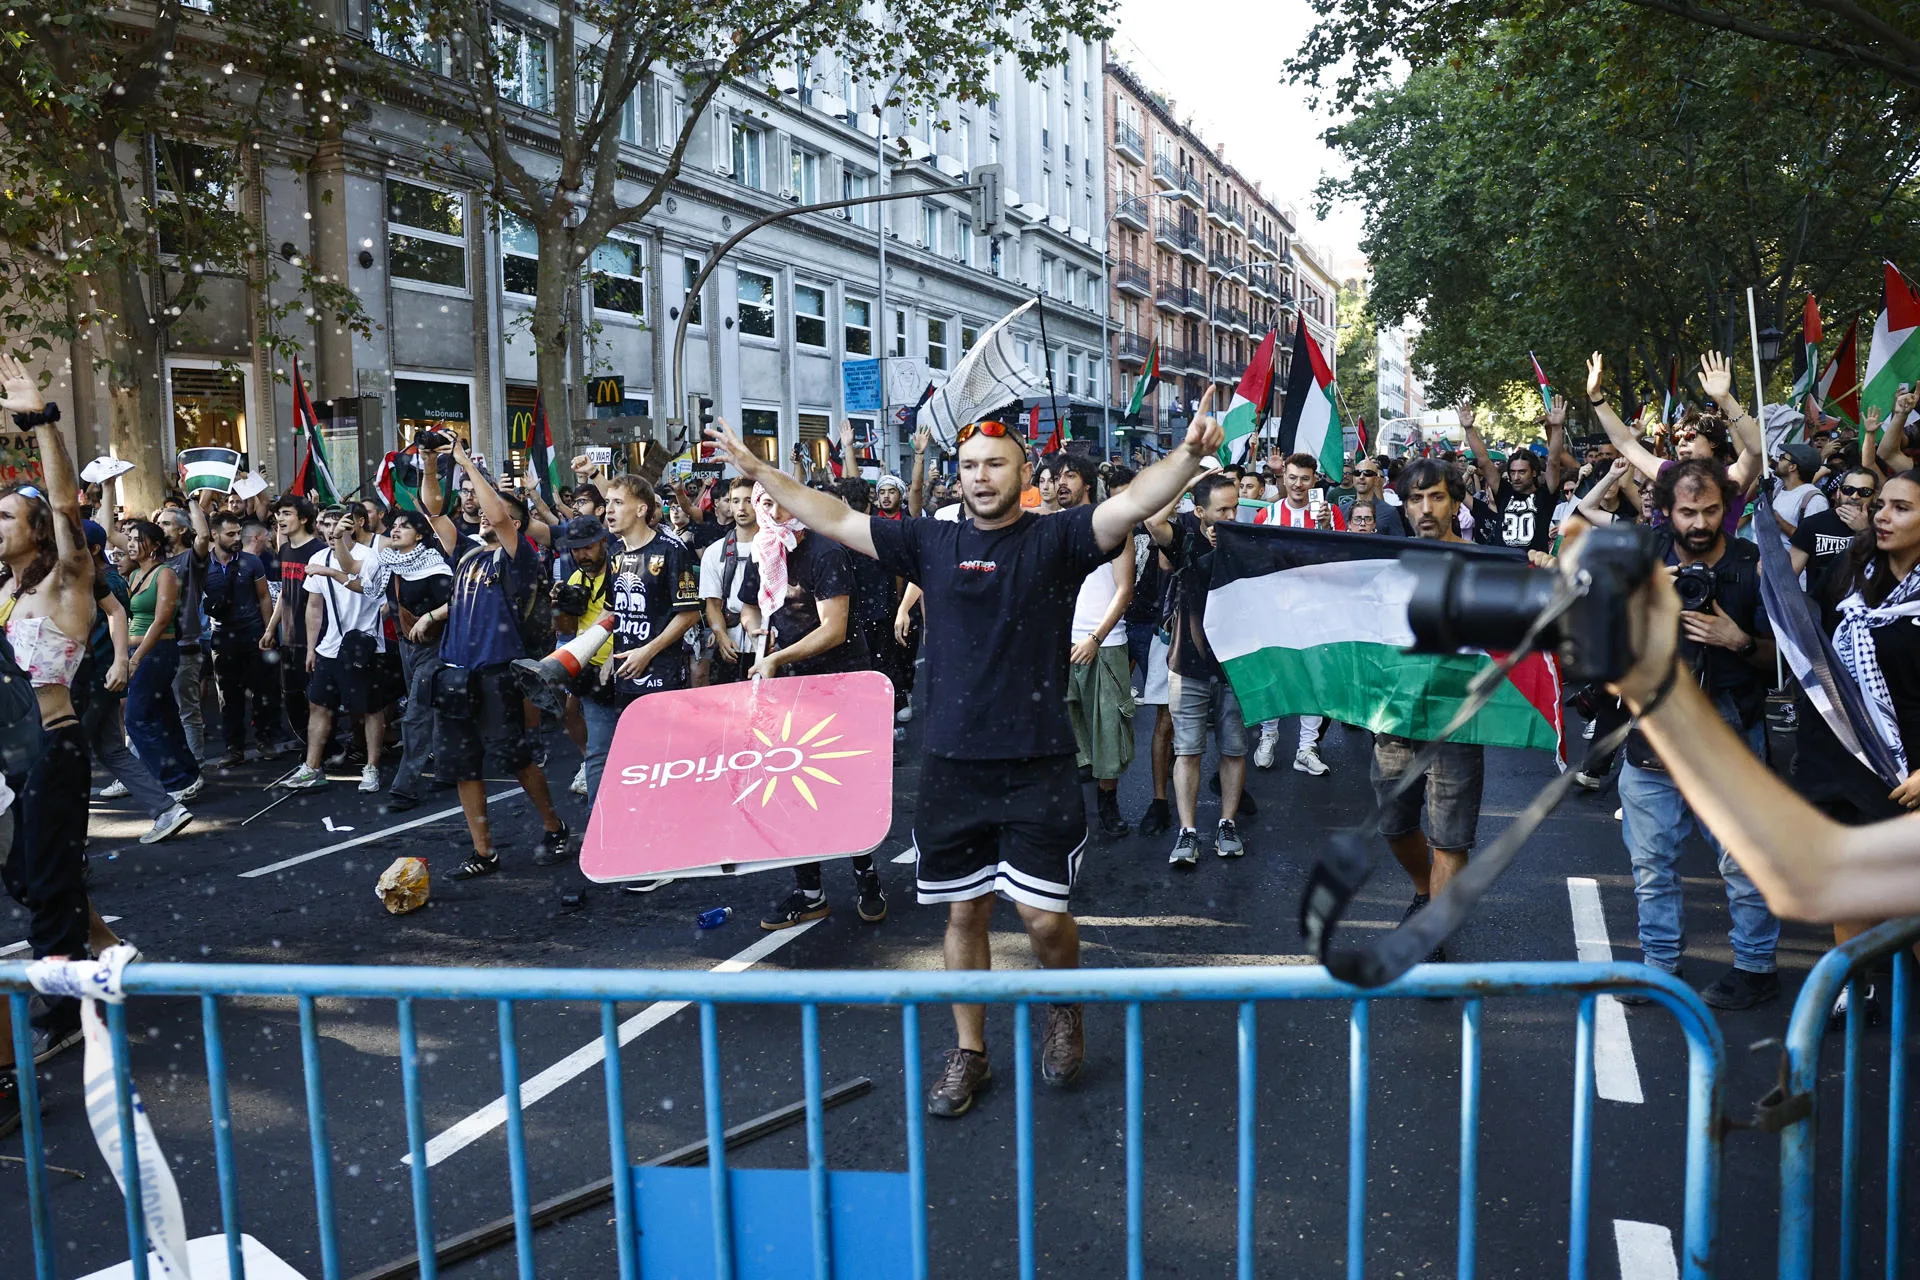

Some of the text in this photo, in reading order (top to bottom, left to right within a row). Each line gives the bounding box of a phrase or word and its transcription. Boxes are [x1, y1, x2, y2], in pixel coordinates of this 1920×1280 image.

[424, 409, 464, 418] McDonald's
[595, 451, 612, 461] WAR
[1502, 513, 1535, 542] 30
[646, 679, 663, 688] AIS
